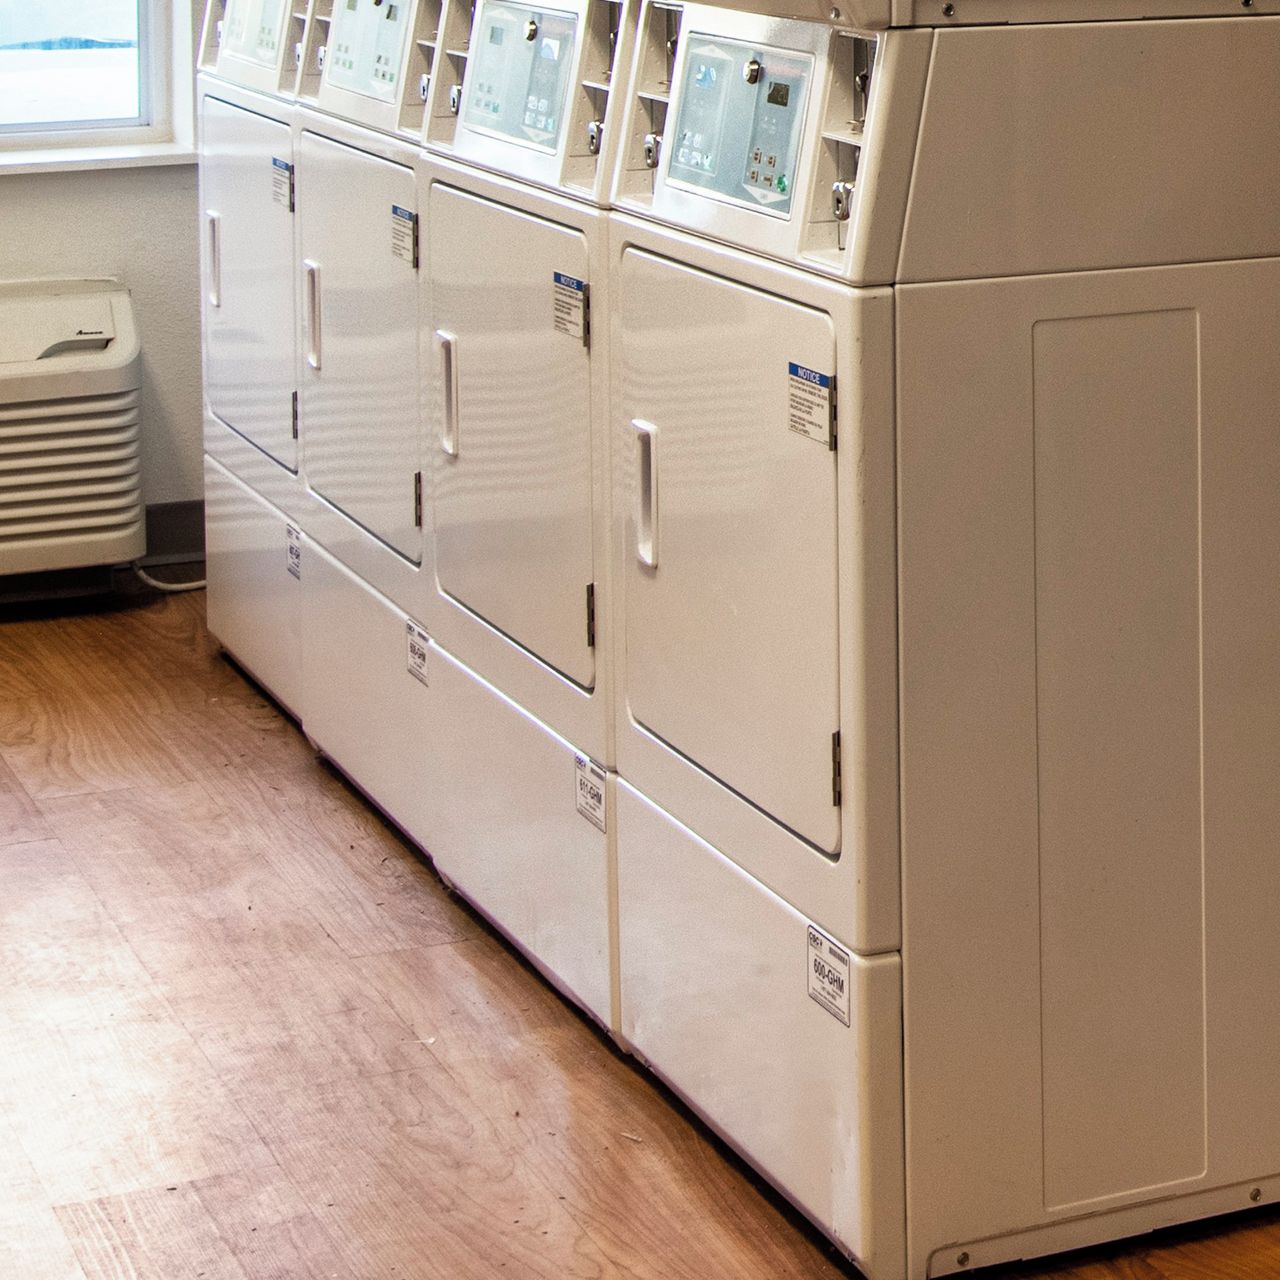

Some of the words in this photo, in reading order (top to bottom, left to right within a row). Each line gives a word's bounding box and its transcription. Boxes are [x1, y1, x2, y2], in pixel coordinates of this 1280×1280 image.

[560, 275, 577, 288] NOTICE
[797, 367, 820, 384] NOTICE
[813, 958, 844, 994] 600-GHM
